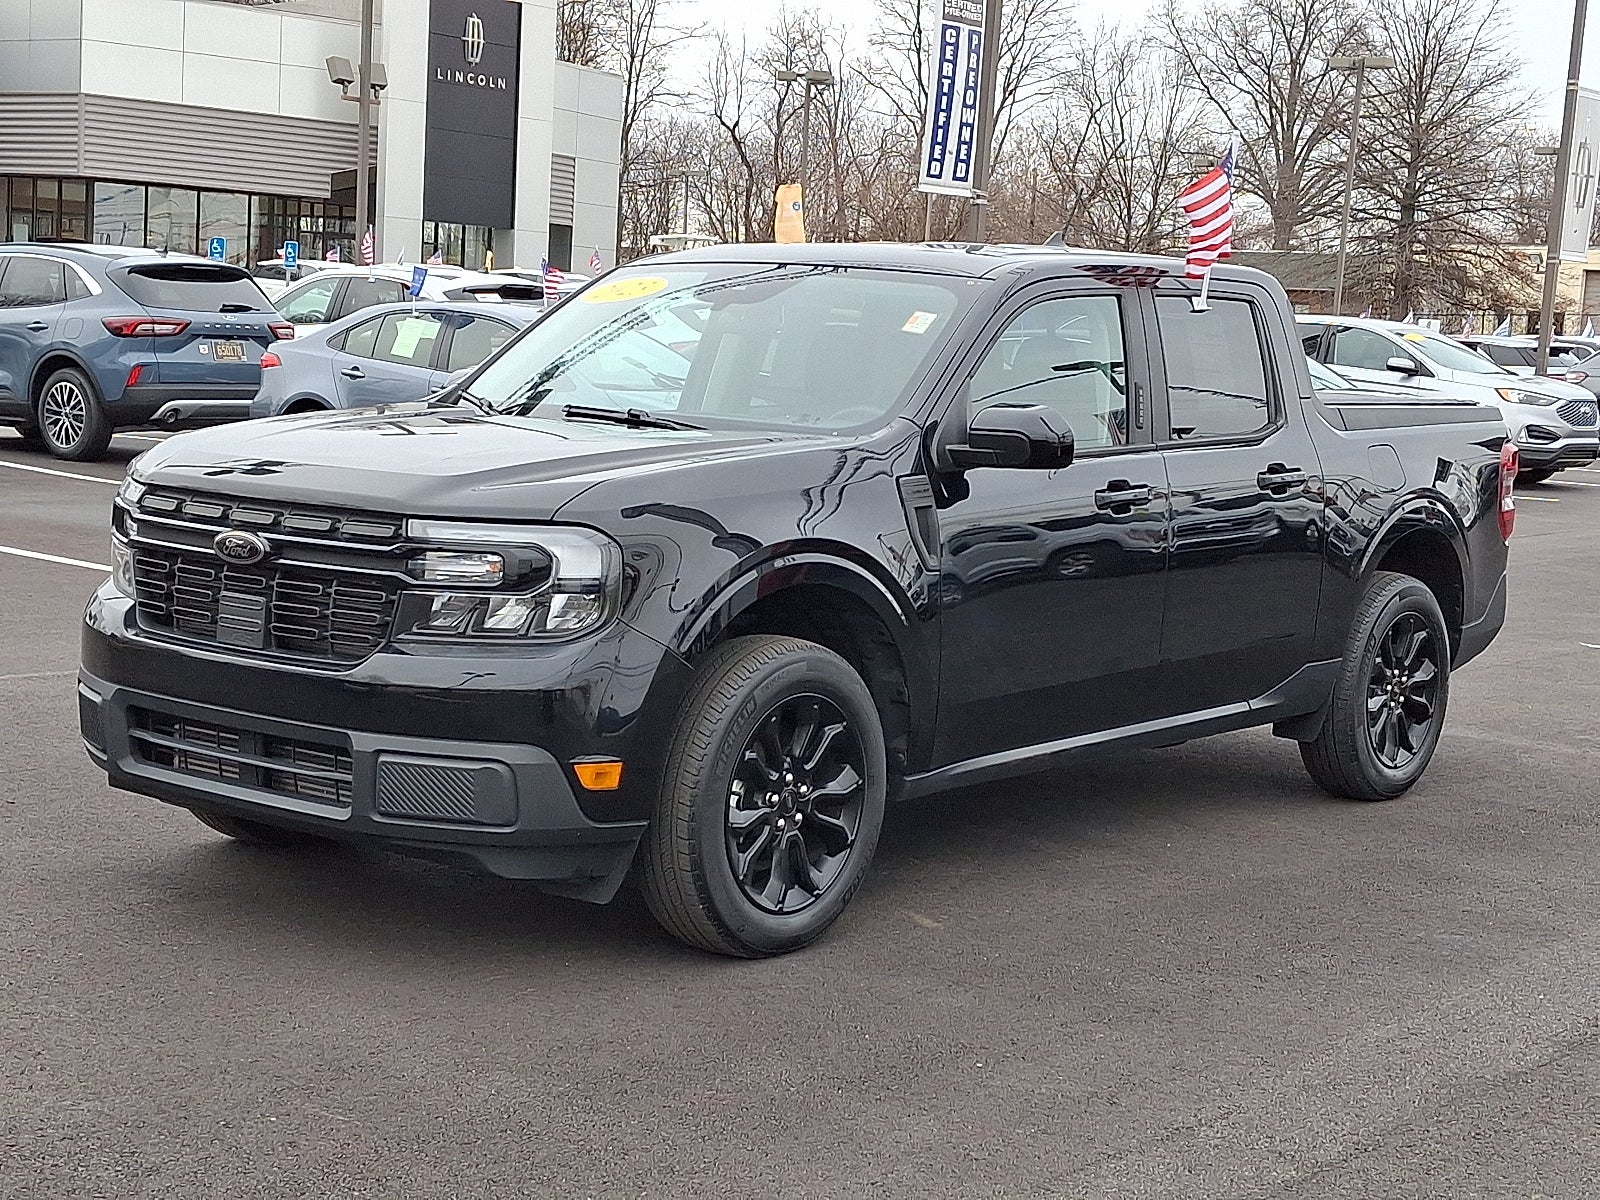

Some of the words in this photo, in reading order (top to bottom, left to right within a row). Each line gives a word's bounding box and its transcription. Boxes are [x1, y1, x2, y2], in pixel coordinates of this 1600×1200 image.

[437, 67, 506, 90] LINCOLN
[929, 28, 957, 175] CERTIFIED
[955, 34, 979, 178] PREOWNED
[222, 537, 252, 557] Ford
